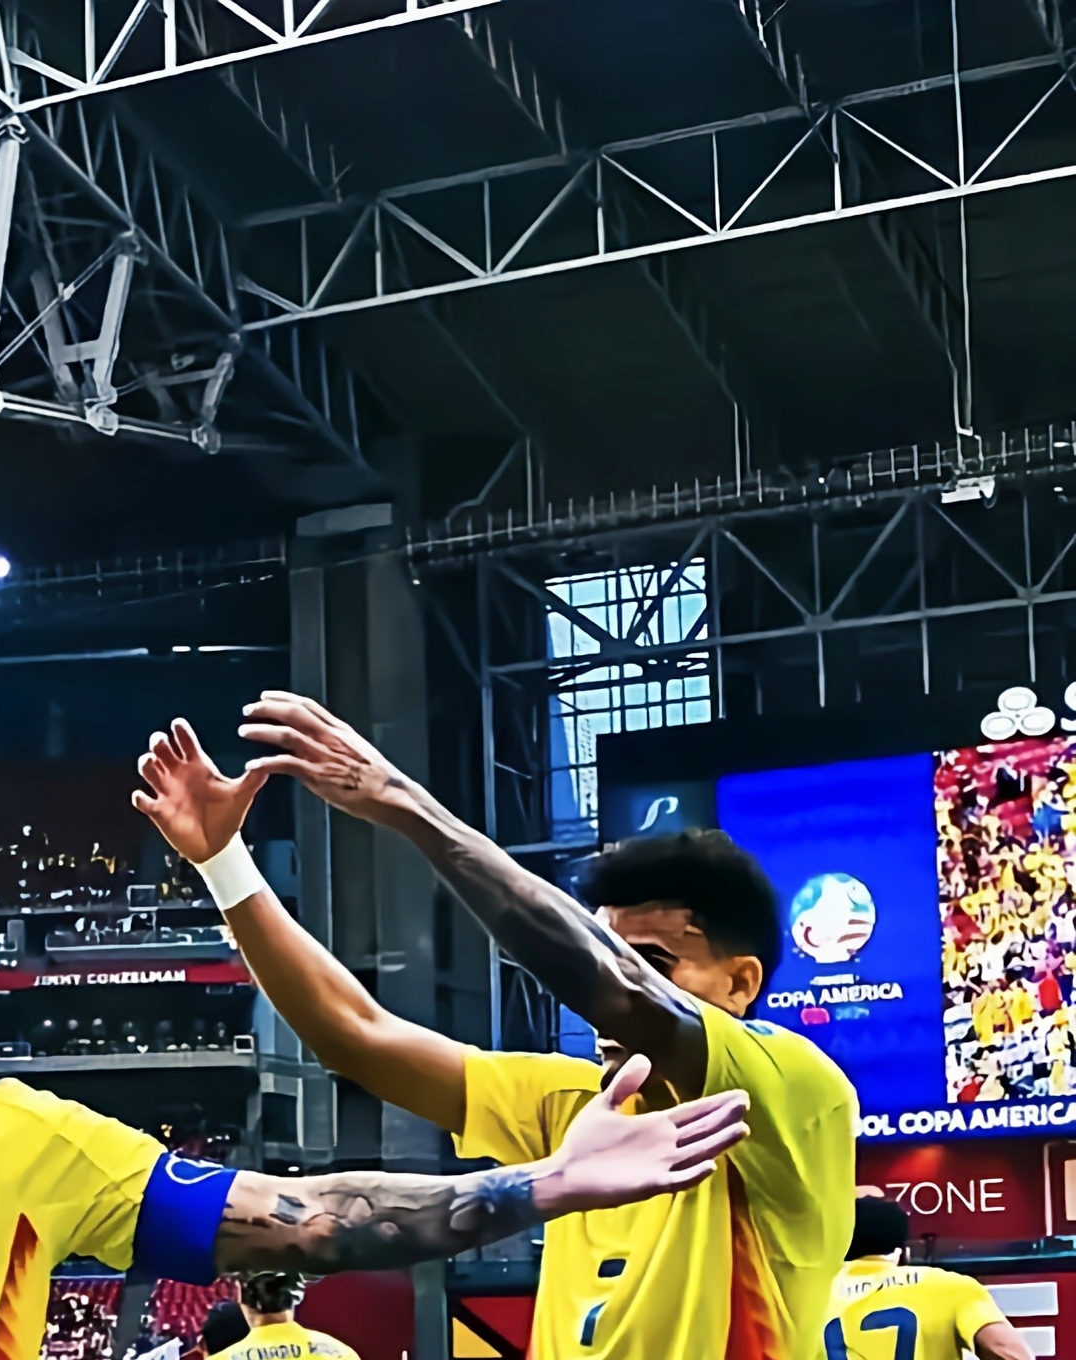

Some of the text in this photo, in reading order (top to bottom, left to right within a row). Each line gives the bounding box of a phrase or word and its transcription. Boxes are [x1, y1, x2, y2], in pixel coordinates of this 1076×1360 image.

[767, 982, 903, 1008] COPA AMERICA
[854, 1114, 897, 1137] OL
[898, 1108, 967, 1135] COPA
